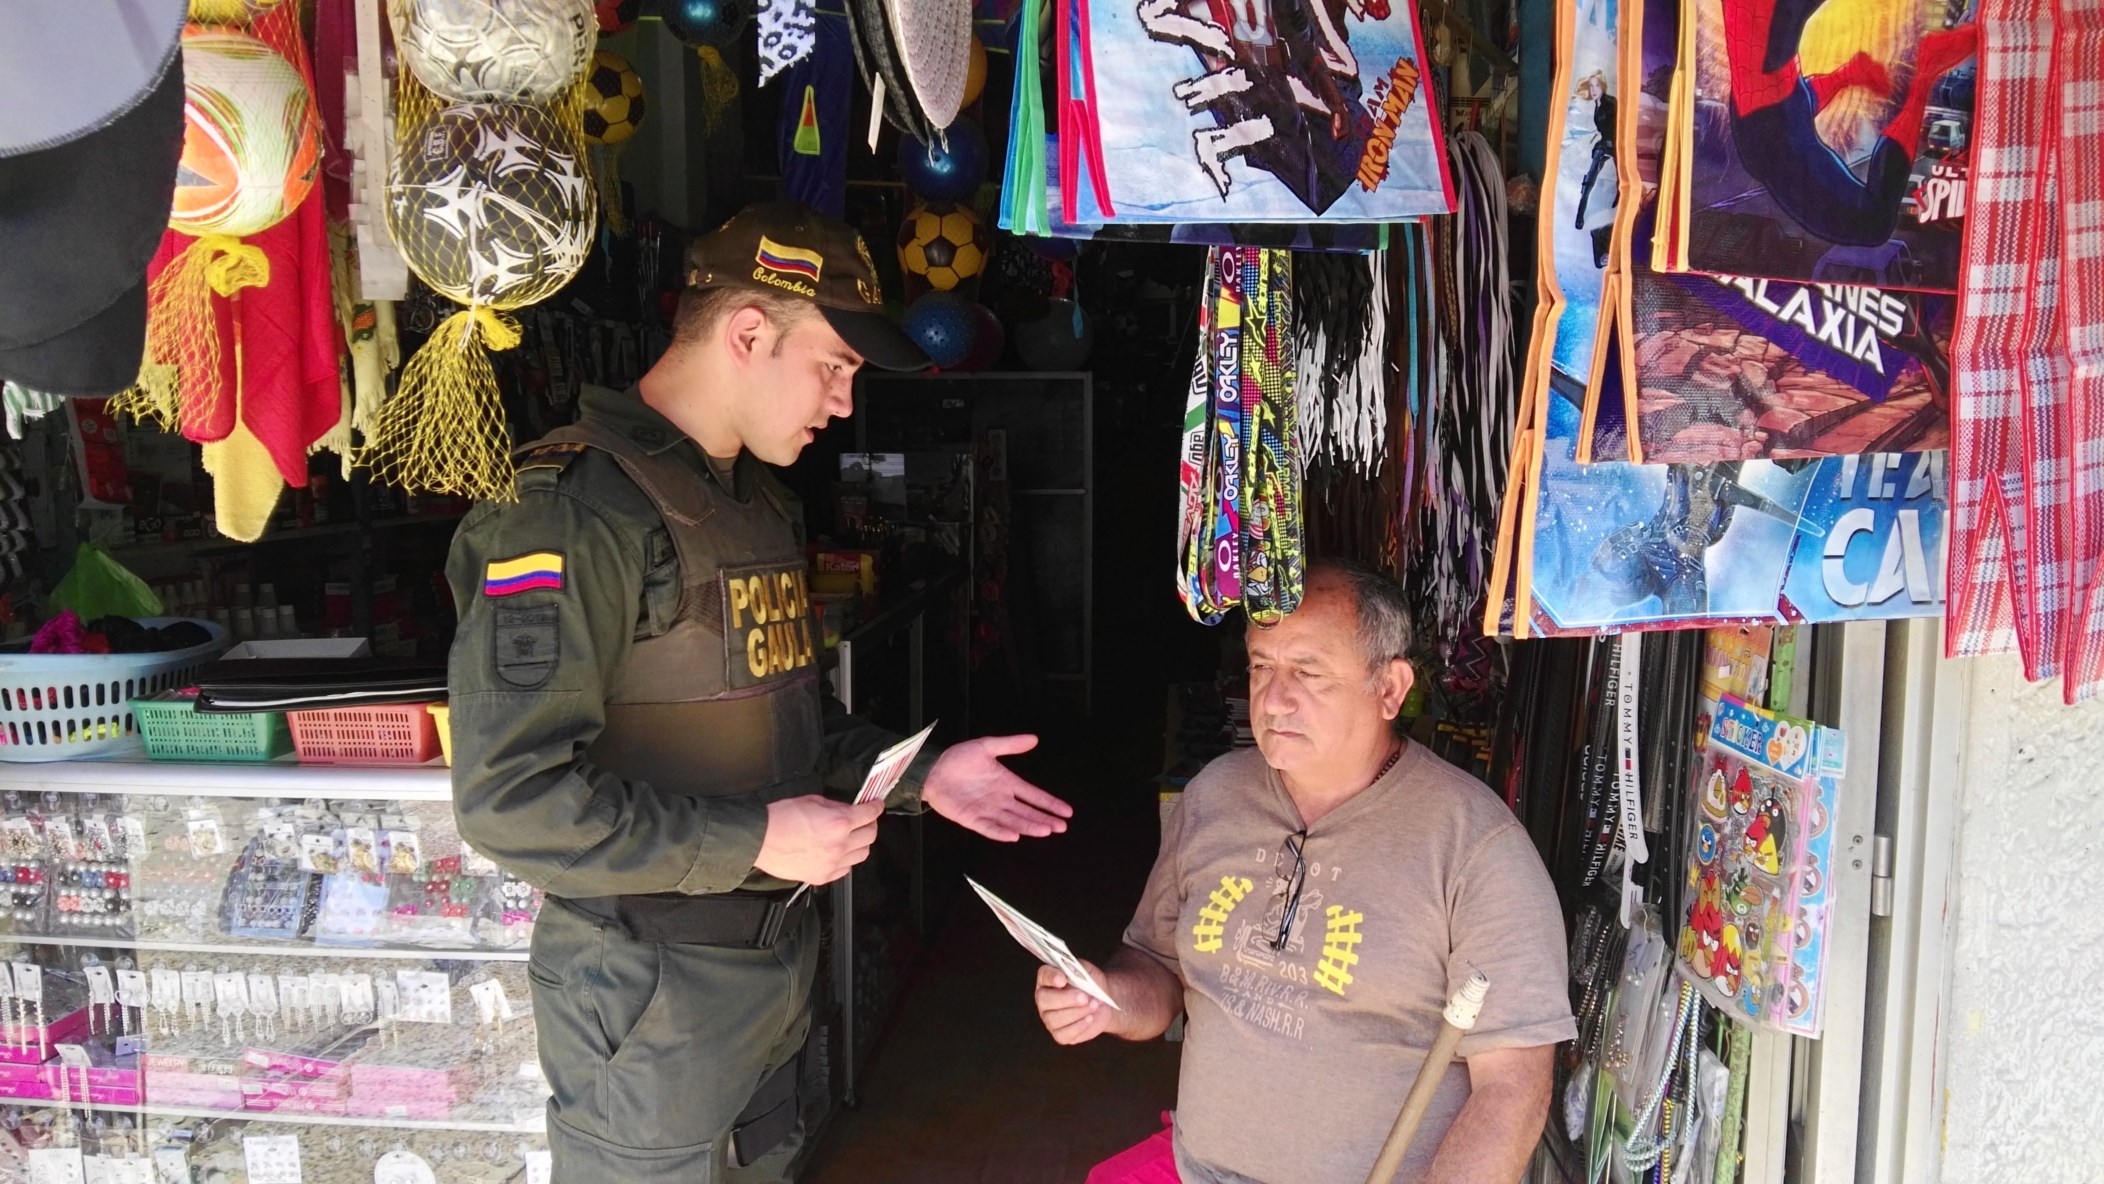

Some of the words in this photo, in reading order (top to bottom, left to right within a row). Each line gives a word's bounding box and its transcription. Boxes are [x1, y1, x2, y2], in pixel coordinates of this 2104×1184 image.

[1356, 117, 1396, 192] IRON
[1380, 58, 1420, 126] MAN
[752, 266, 816, 297] Colombia
[1217, 331, 1239, 403] OAKLEY
[1222, 433, 1239, 502] OAKLEY
[1822, 508, 1949, 605] CA
[1604, 643, 1622, 707] HILFIGER
[1623, 682, 1634, 745] TOMMY
[1590, 754, 1607, 807] TOMMY
[1625, 773, 1639, 840] HILFIGER
[1255, 848, 1342, 881] DEOT
[1242, 991, 1274, 1005] AND
[1279, 960, 1308, 985] 203
